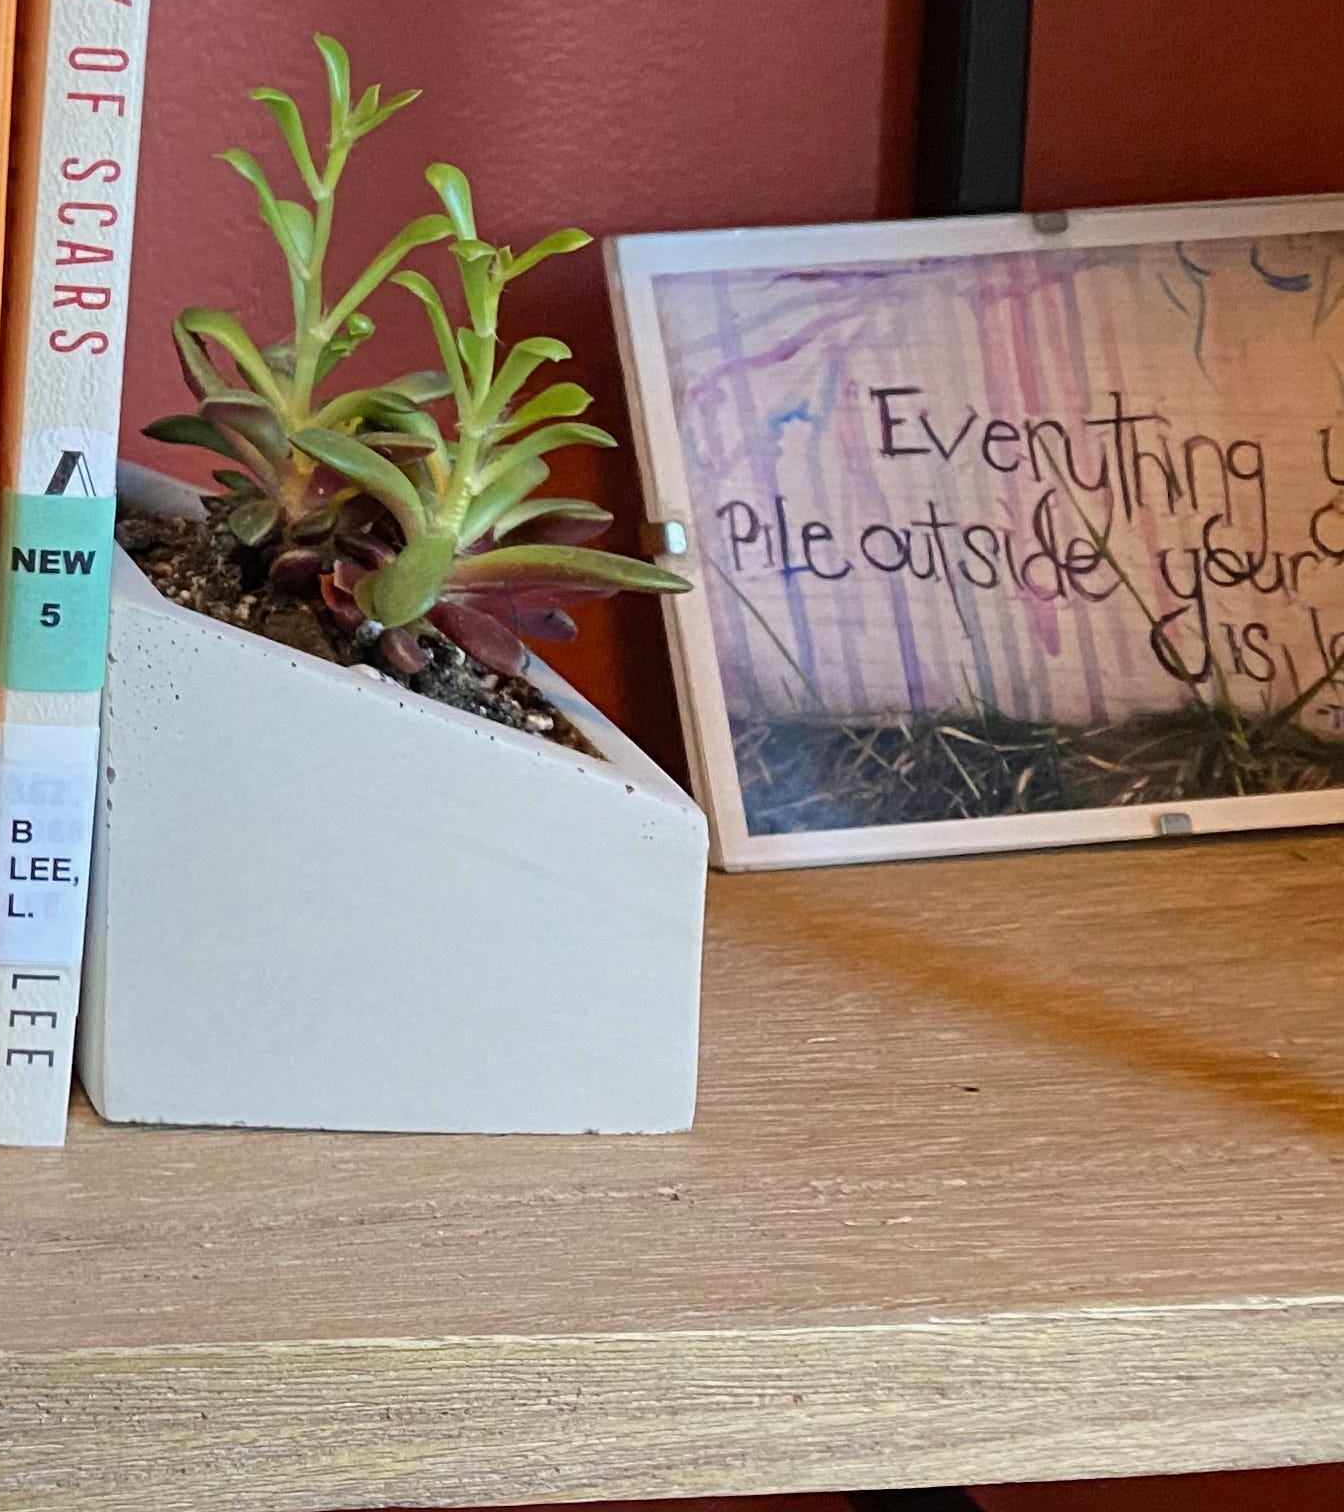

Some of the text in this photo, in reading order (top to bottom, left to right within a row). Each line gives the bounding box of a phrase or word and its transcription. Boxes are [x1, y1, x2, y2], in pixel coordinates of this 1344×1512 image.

[67, 46, 130, 118] OF
[49, 157, 121, 355] SCARS
[11, 548, 96, 576] NEW
[40, 603, 61, 628] 5
[11, 819, 34, 844] B
[9, 856, 80, 887] LEE,
[7, 892, 34, 918] L.
[6, 973, 60, 1067] LEE
